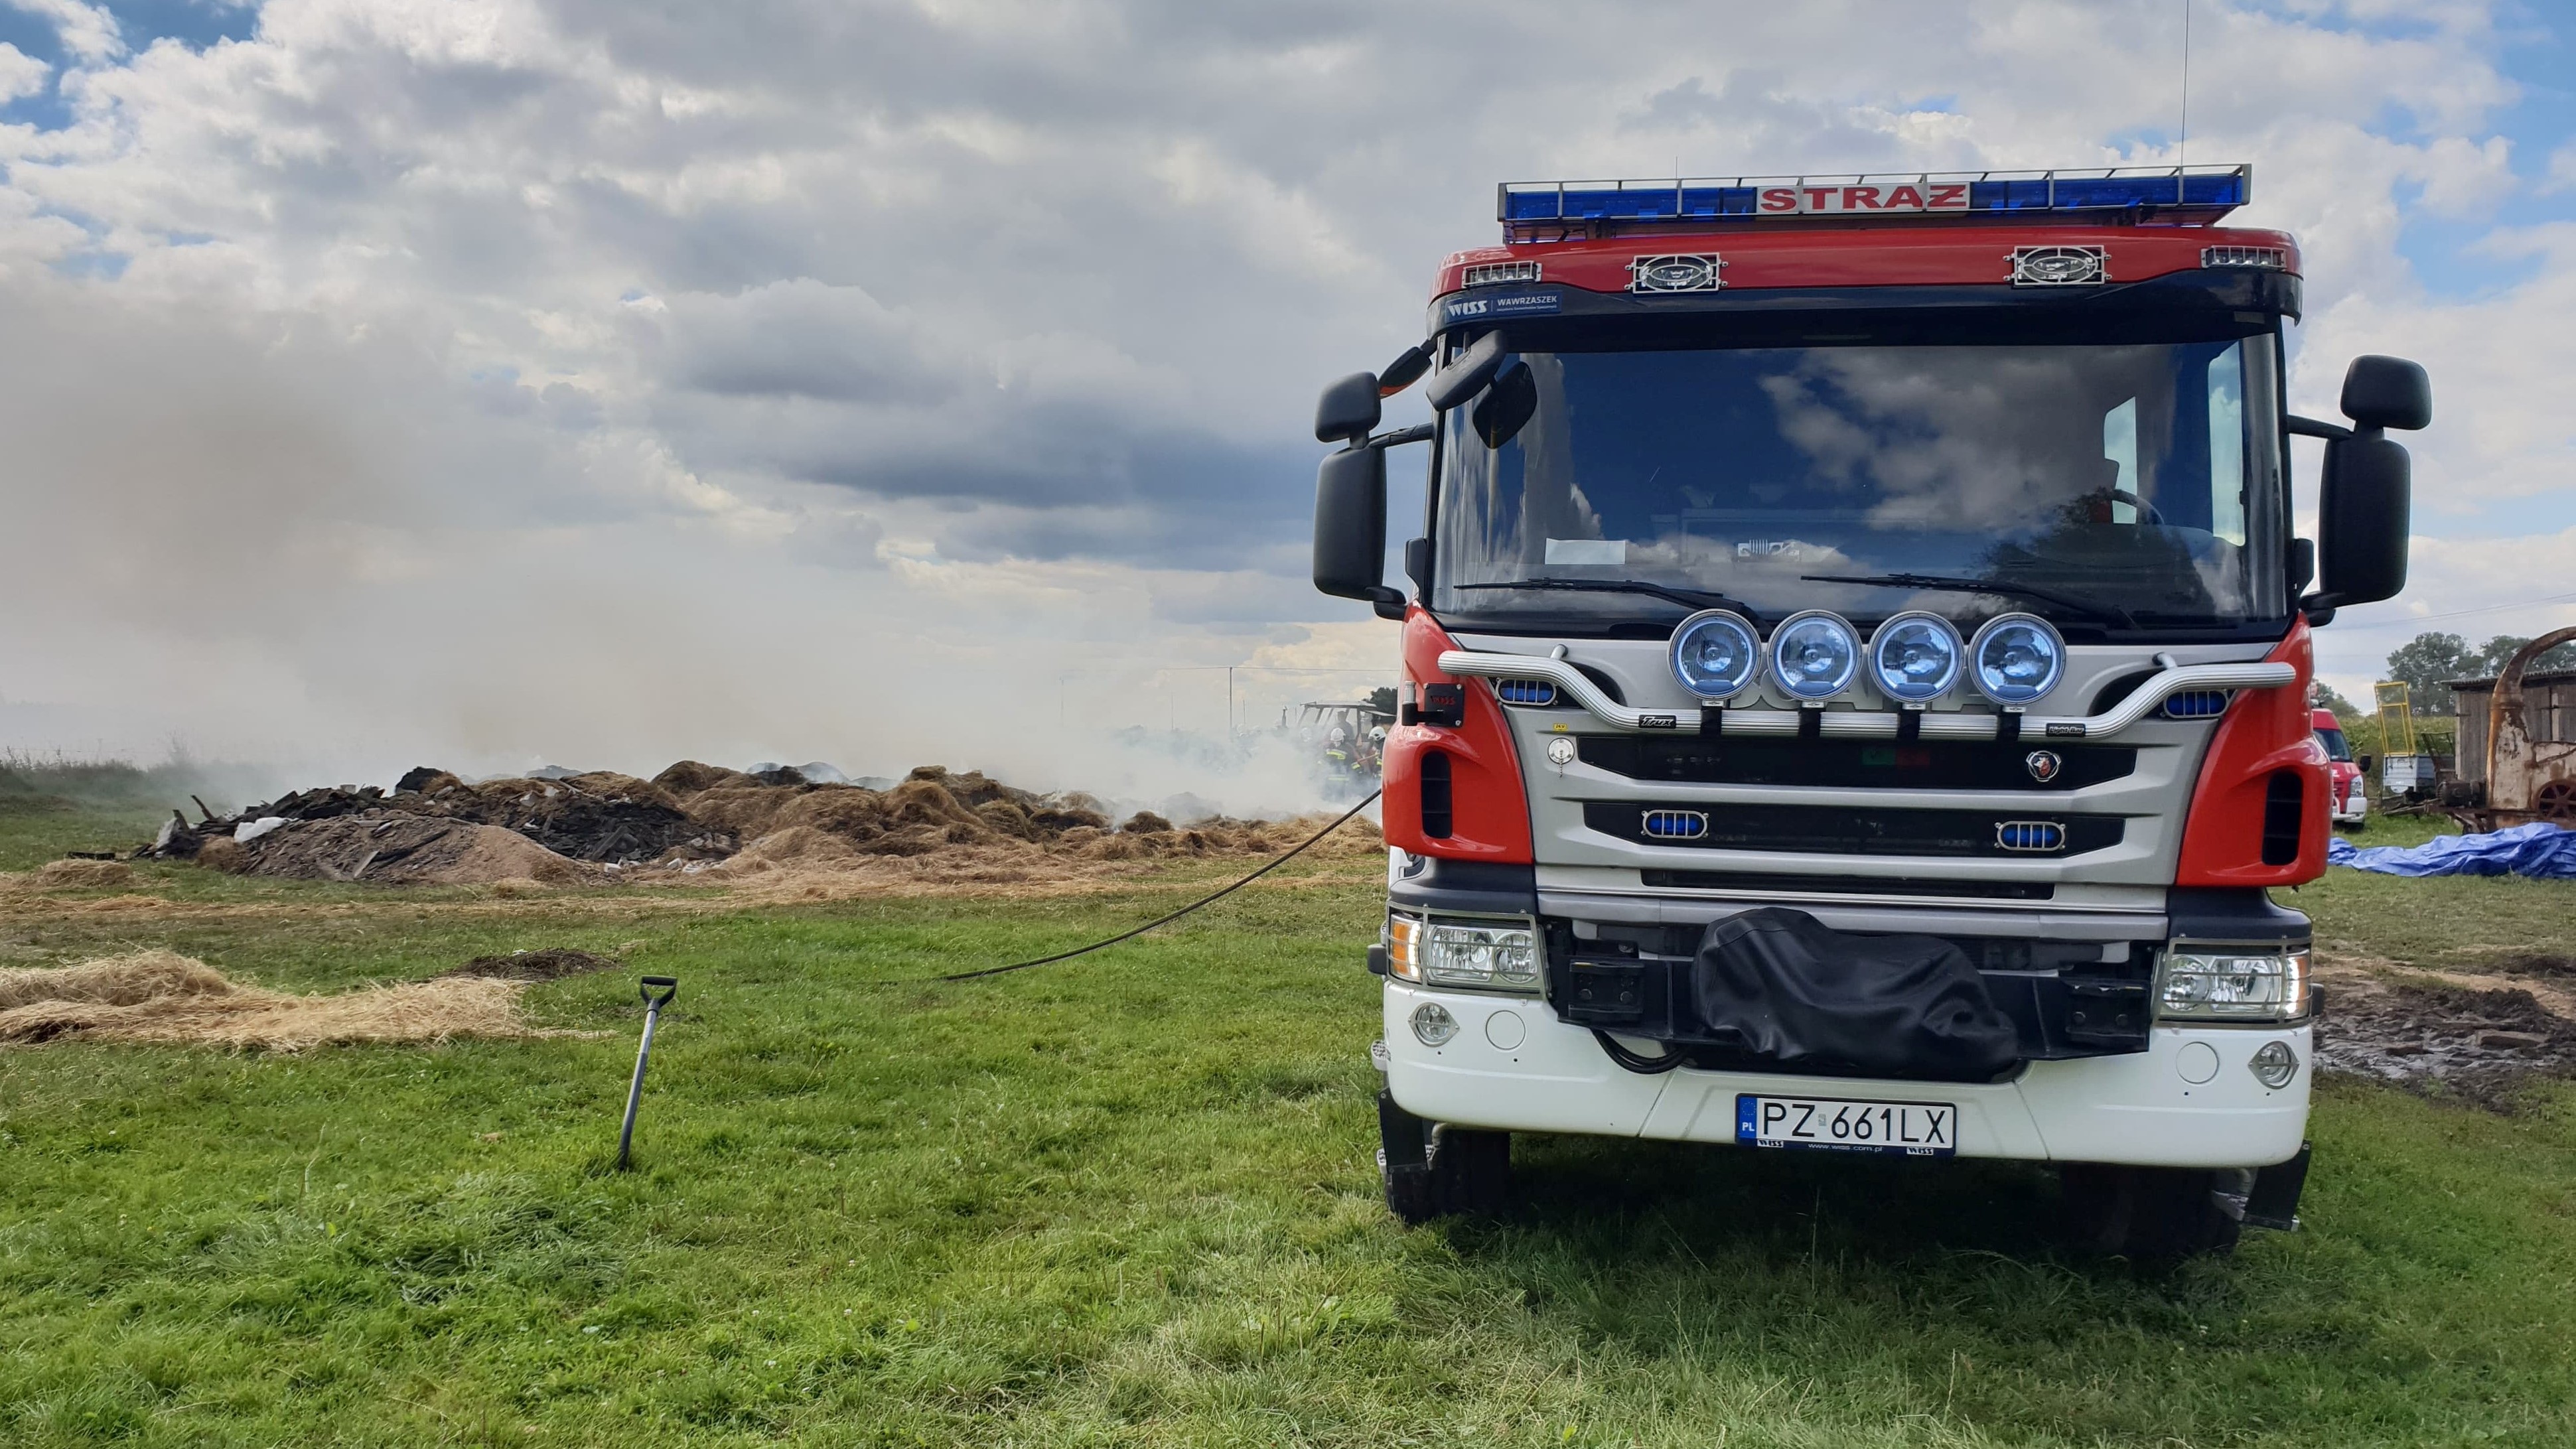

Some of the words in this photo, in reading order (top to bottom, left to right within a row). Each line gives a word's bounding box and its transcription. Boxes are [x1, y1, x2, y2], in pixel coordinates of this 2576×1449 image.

[1498, 296, 1557, 306] WAWRZASZEK
[1448, 301, 1487, 316] WISS
[1642, 716, 1674, 726] Trux
[1742, 1122, 1755, 1132] PL
[1763, 1102, 1815, 1137] PZ
[1831, 1106, 1945, 1143] 661LX
